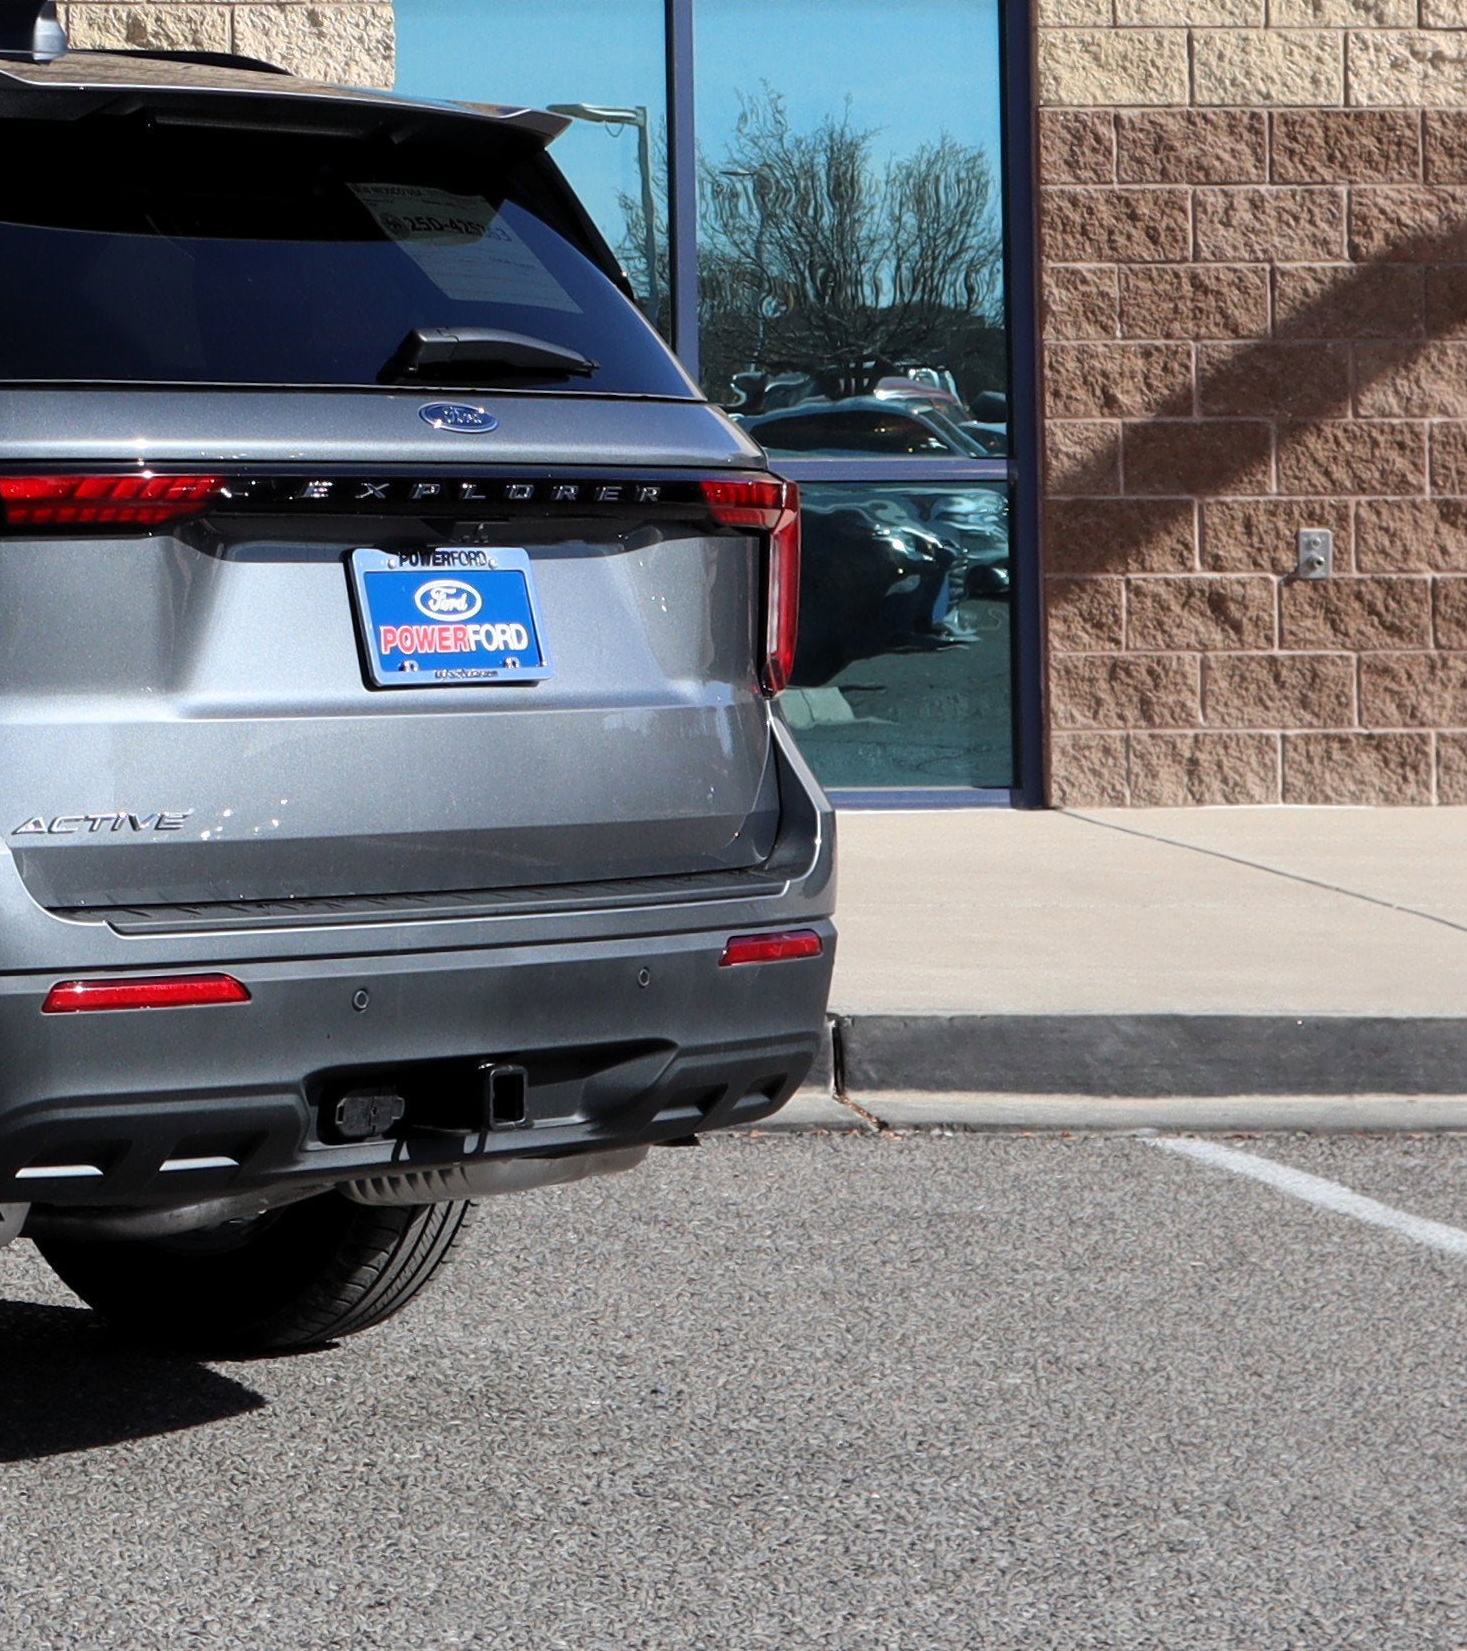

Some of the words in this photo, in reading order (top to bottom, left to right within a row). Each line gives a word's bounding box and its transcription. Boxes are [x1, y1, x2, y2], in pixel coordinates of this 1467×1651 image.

[303, 481, 660, 501] EXPLORER
[428, 587, 468, 612] Ford
[381, 623, 528, 654] POWERFORD
[11, 808, 195, 836] ACTIVE
